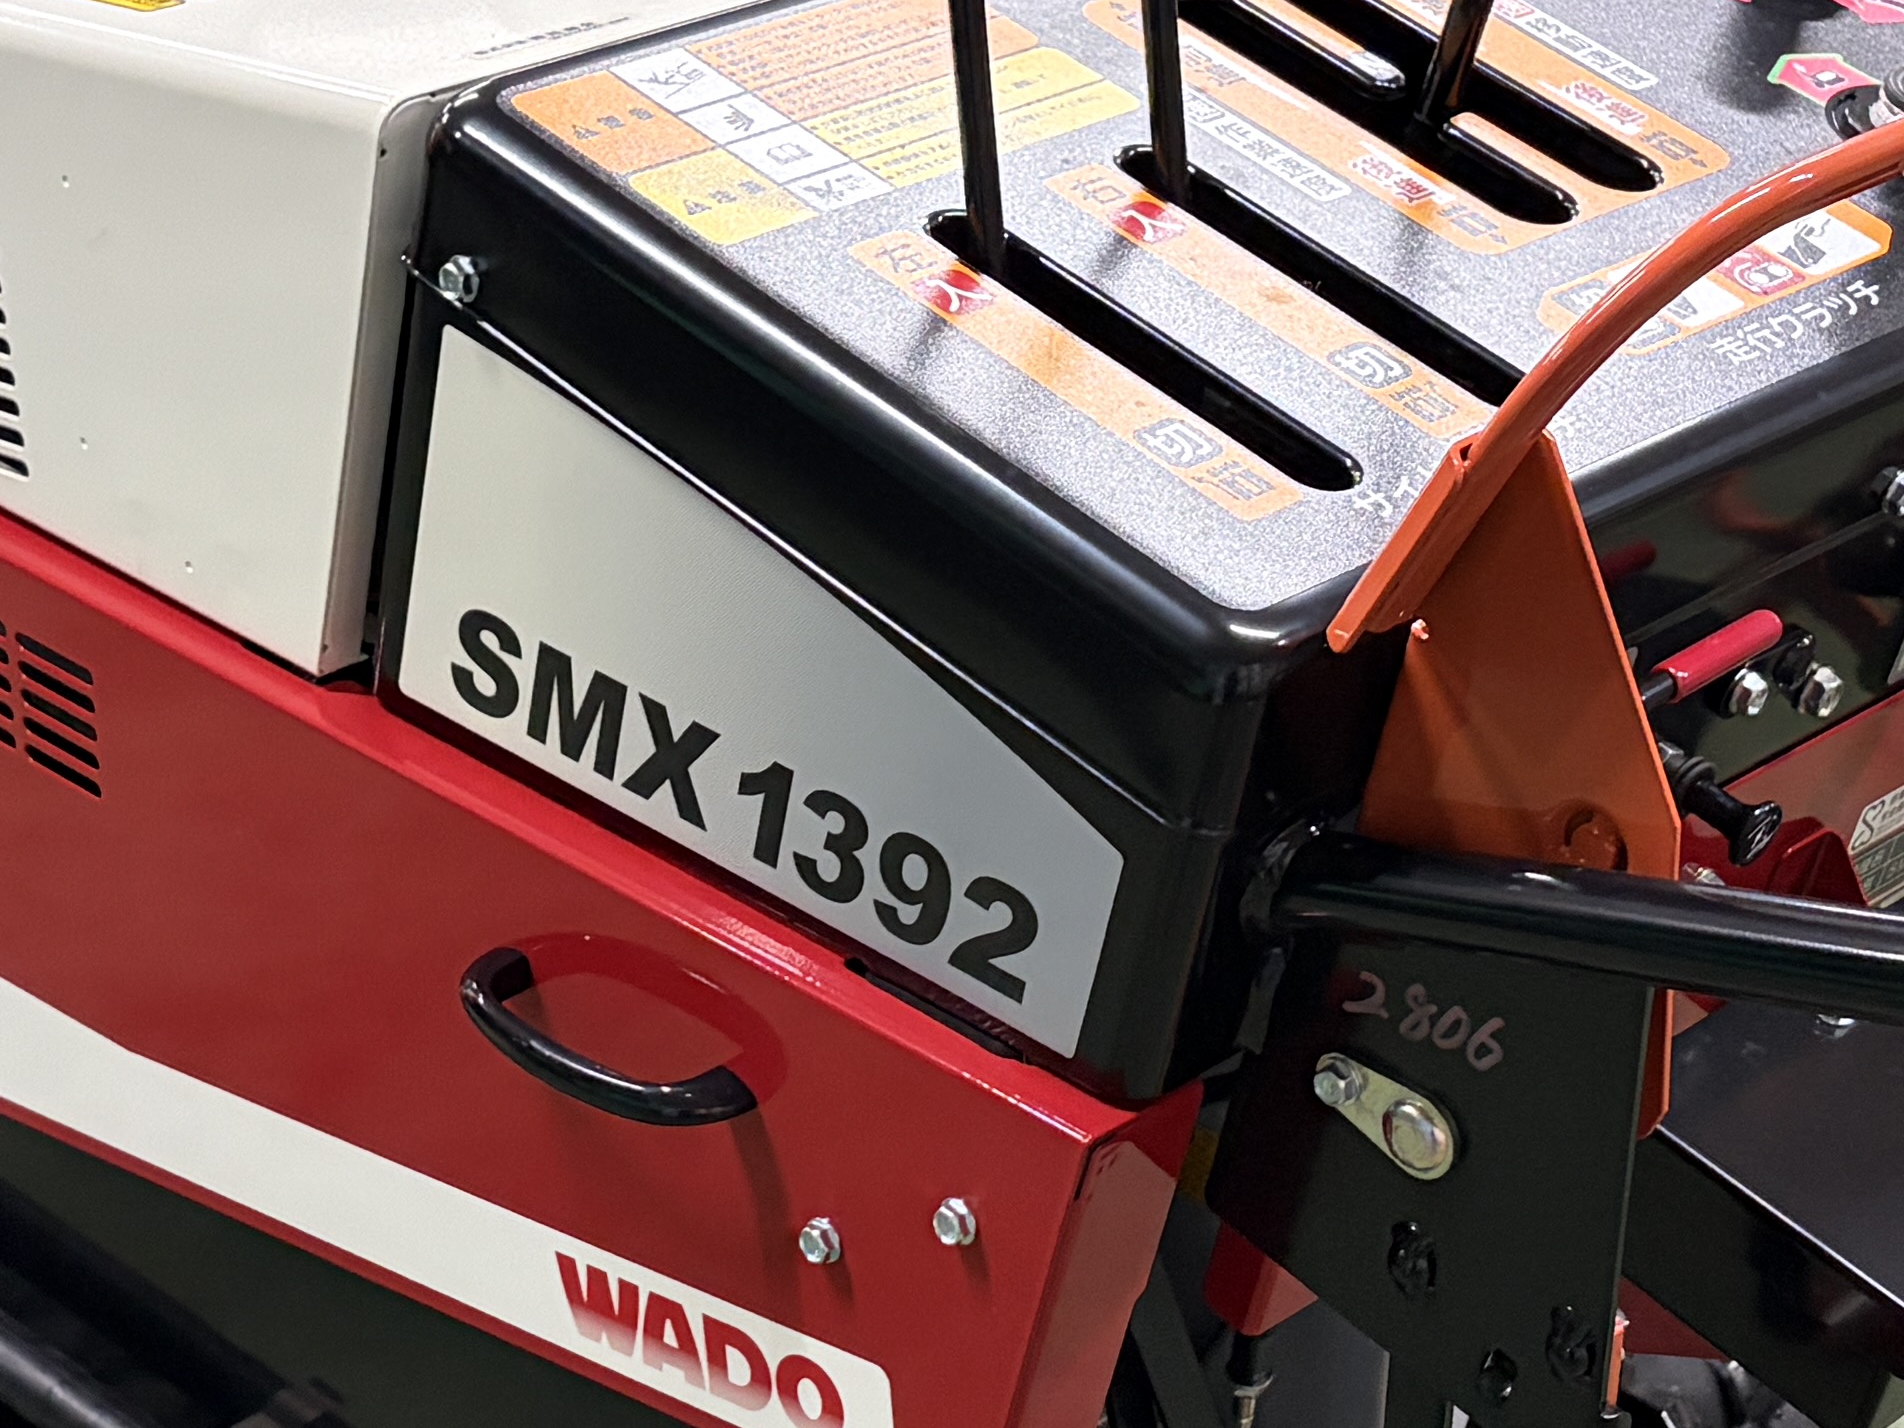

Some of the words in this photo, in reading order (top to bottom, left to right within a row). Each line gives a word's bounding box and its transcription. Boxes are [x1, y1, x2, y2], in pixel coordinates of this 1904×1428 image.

[1068, 172, 1129, 205] 右
[1116, 204, 1185, 242] 入
[871, 240, 937, 276] 左
[920, 272, 993, 314] 入
[1707, 278, 1881, 365] 走行クラッチ
[1334, 344, 1406, 384] 切
[1143, 423, 1215, 463] 切
[1342, 970, 1506, 1072] 2806
